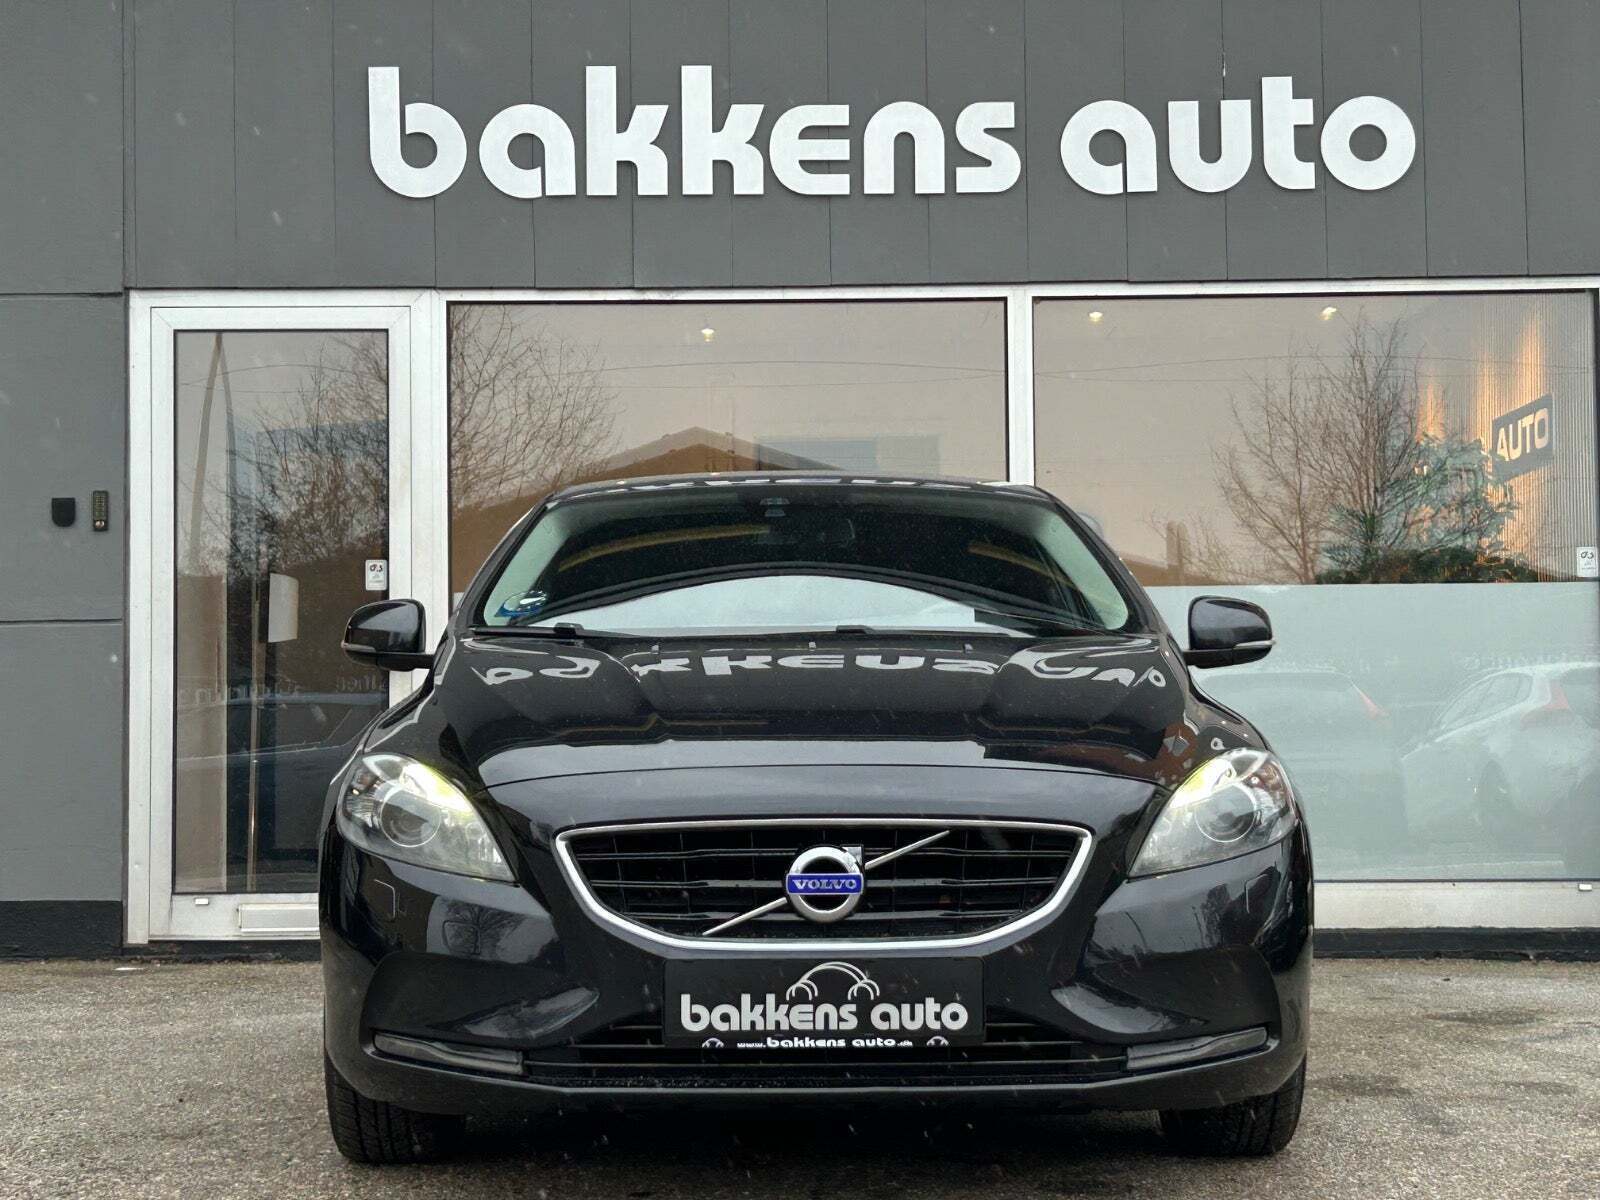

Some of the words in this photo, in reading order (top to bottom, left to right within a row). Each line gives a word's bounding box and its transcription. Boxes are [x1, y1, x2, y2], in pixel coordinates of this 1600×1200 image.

[368, 65, 1022, 199] bakkens
[1060, 75, 1416, 194] auto
[1496, 407, 1549, 461] AUTO
[792, 879, 857, 890] VOLVO
[680, 993, 858, 1032] bakkens
[870, 997, 968, 1031] auto
